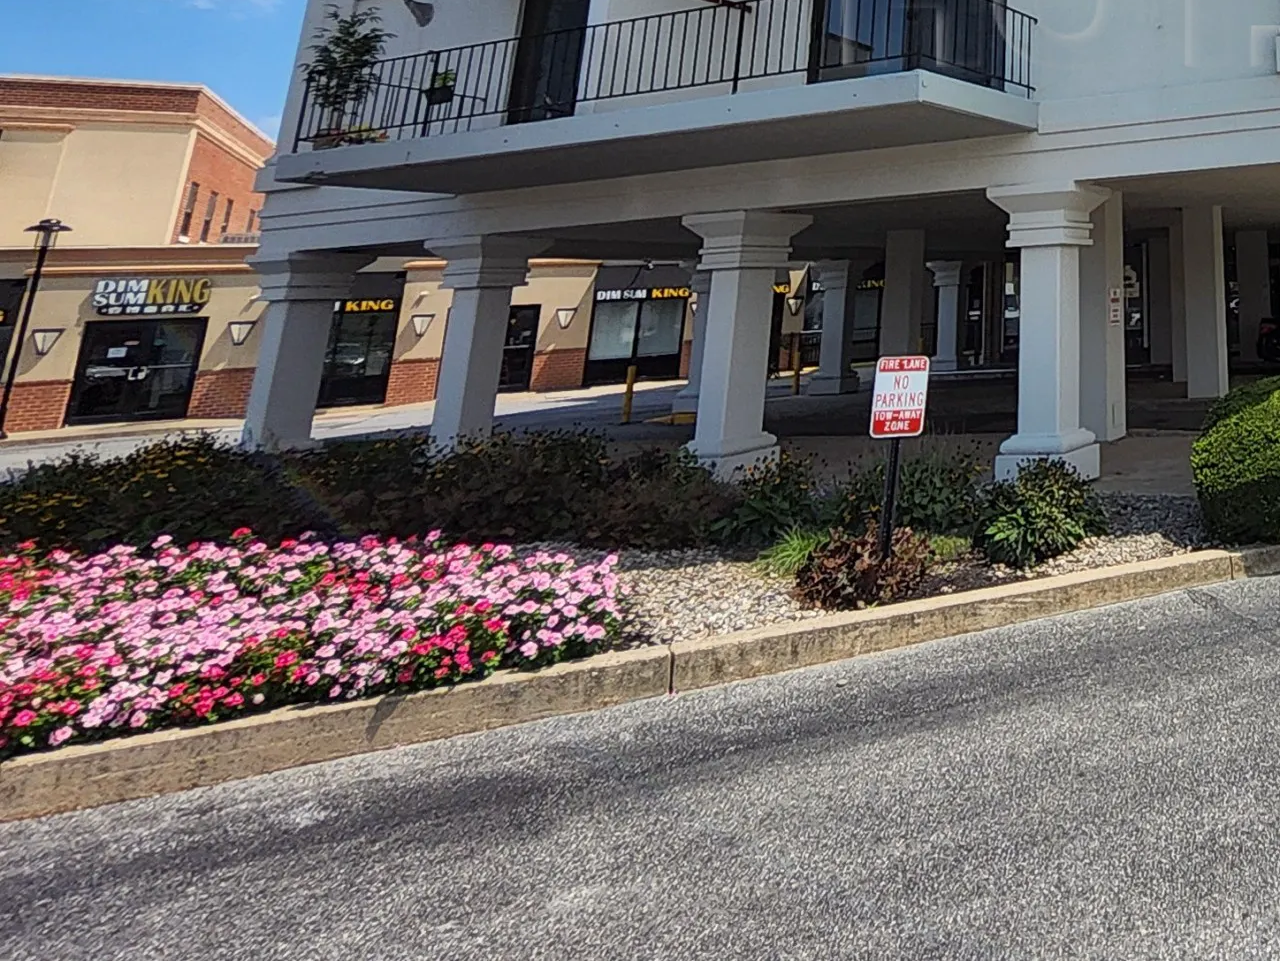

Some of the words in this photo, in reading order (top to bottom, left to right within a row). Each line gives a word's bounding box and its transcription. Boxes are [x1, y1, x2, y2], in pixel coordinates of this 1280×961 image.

[96, 278, 149, 293] DIM
[146, 277, 211, 304] KING
[92, 292, 146, 307] SUM
[596, 289, 621, 300] DIM
[622, 288, 647, 299] SUM
[651, 287, 689, 299] KING
[344, 299, 394, 312] KING
[880, 359, 900, 370] FIRE
[903, 359, 926, 370] LANE
[893, 375, 910, 390] NO
[875, 392, 924, 408] PARKING
[874, 410, 921, 421] TOW-AWAY
[883, 420, 911, 432] ZONE
